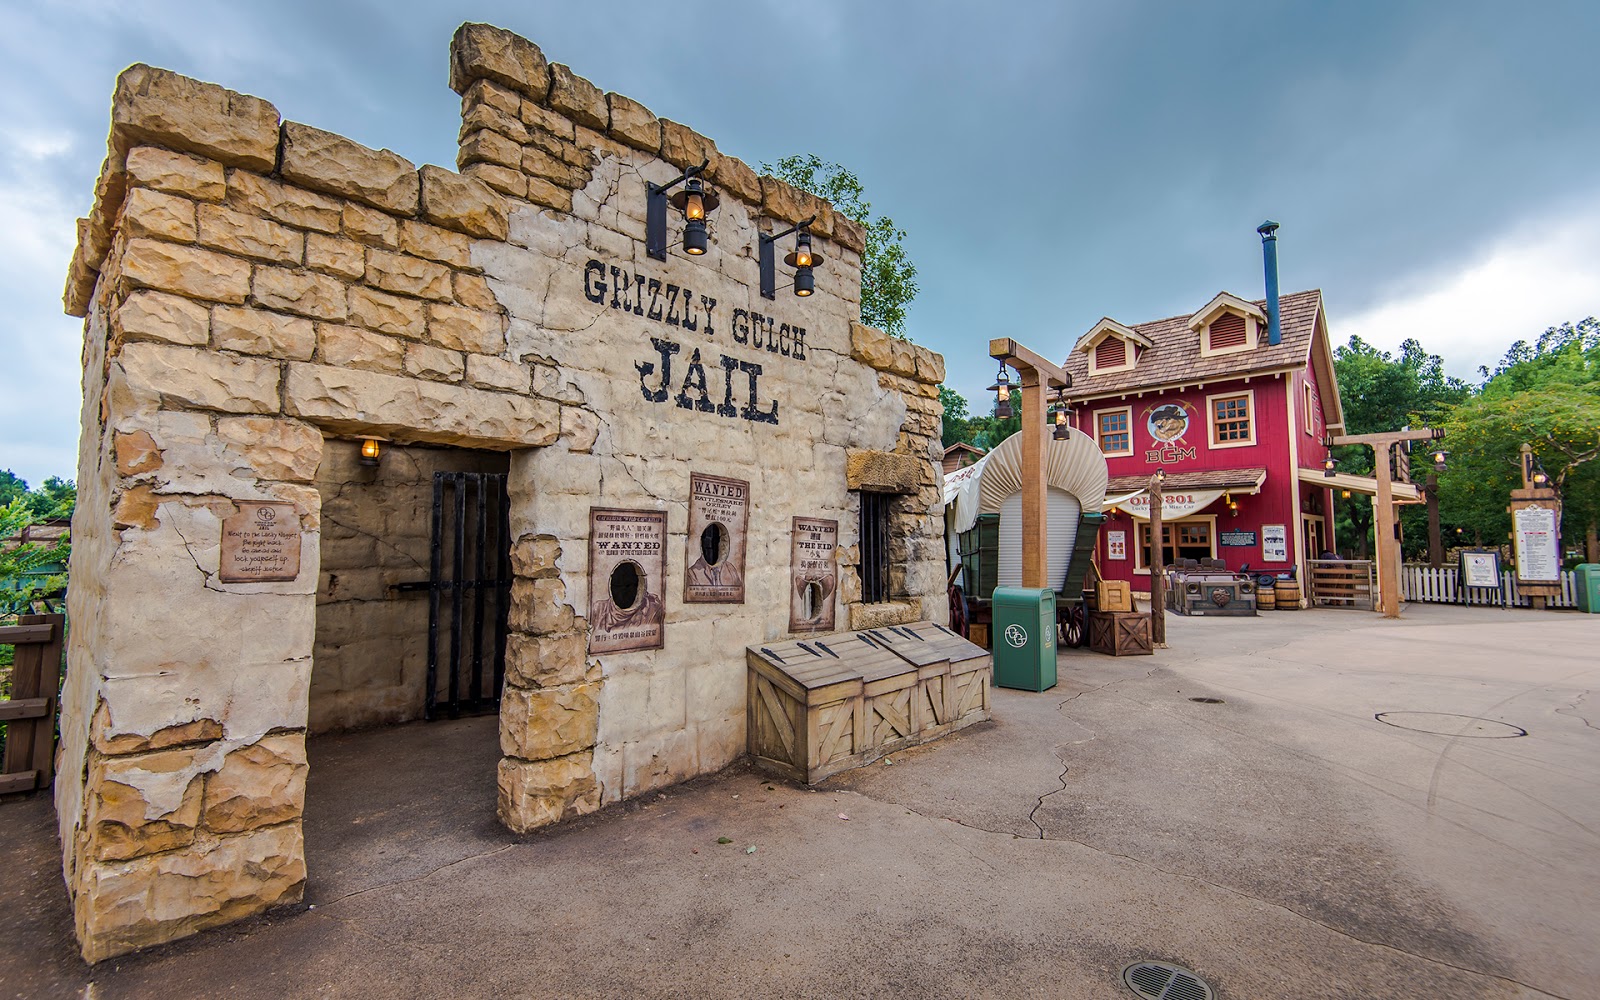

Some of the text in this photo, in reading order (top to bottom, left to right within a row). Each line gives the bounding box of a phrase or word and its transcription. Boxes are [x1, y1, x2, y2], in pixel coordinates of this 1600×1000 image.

[584, 259, 806, 360] GRIZZLY GULCH
[634, 338, 779, 425] JAIL
[695, 481, 745, 498] WANTED!
[695, 495, 743, 506] RATTLESNAKE
[1165, 494, 1195, 505] 801
[798, 524, 835, 533] WANTED
[596, 541, 660, 549] WANTED
